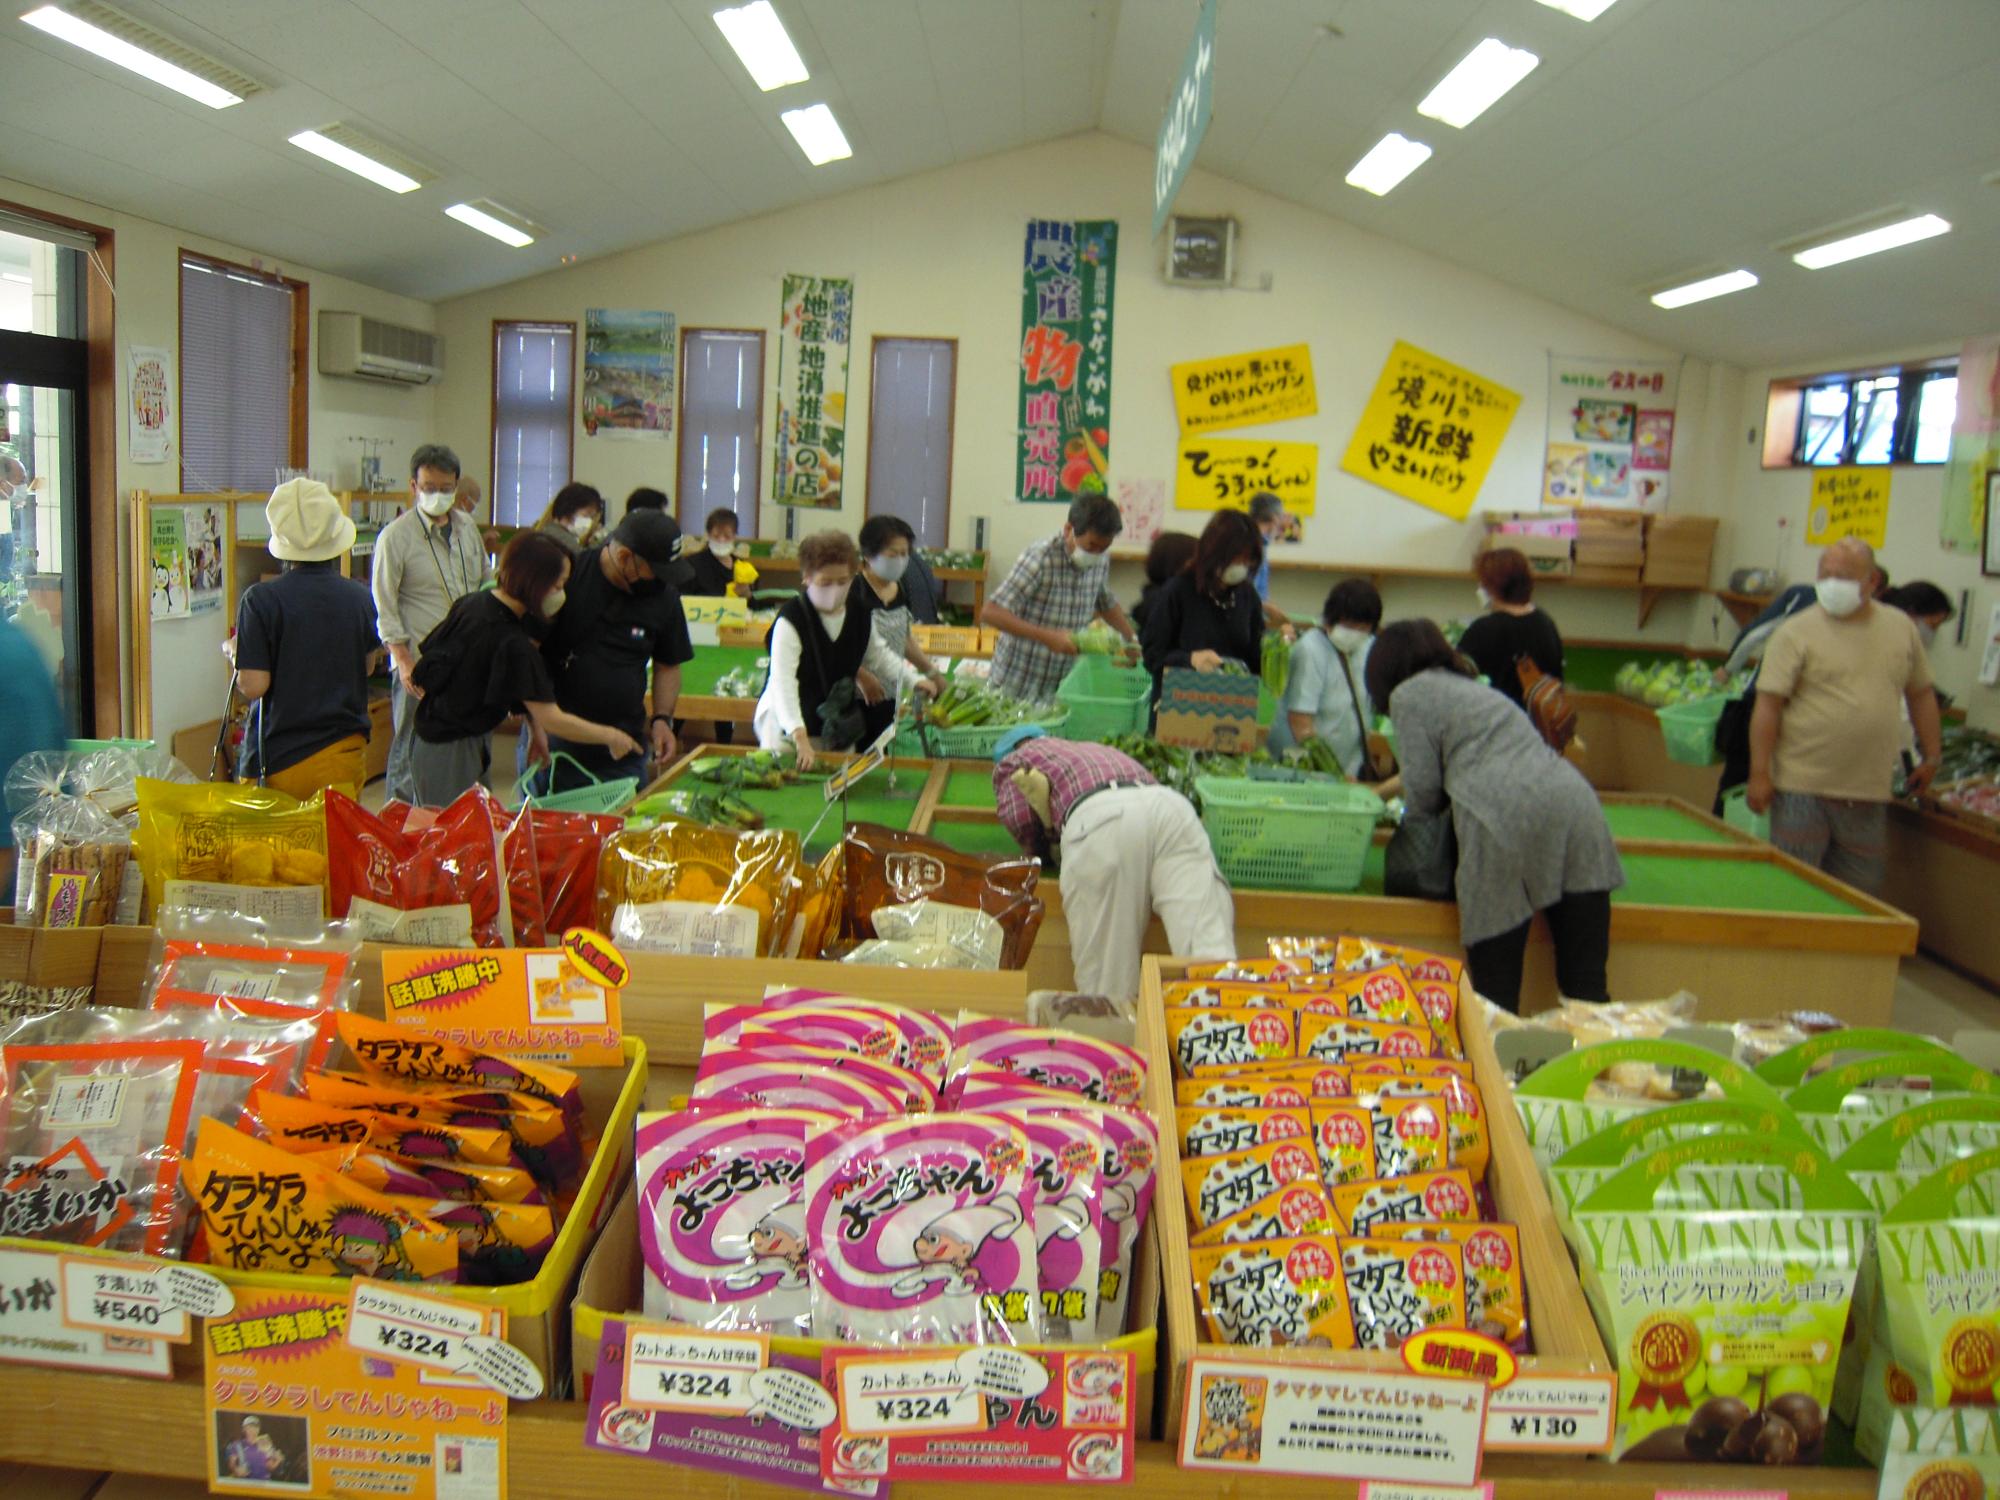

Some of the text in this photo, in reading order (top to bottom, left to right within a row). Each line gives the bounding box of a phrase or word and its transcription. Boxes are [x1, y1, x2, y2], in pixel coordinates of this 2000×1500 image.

[792, 293, 828, 496] 地産地消推進の店
[1390, 413, 1474, 463] 新鮮
[1369, 443, 1467, 493] やさいだけ
[388, 956, 501, 1010] 話題沸騰中
[201, 1170, 307, 1213] タラタラ
[840, 1158, 995, 1240] よっちゃん
[202, 1206, 323, 1242] してんじゃ
[1209, 1258, 1283, 1310] タマタマ
[1345, 1260, 1406, 1293] マタマ
[1620, 1279, 1845, 1306] シャインクロッカンショコラ
[94, 1299, 160, 1325] ¥540
[378, 1325, 450, 1359] ¥324
[1422, 1341, 1498, 1378] 新商品
[658, 1371, 731, 1398] ¥324
[1273, 1379, 1477, 1413] タマタマしてんじゃねーよ
[877, 1397, 951, 1421] ¥324
[1510, 1416, 1577, 1437] ¥130
